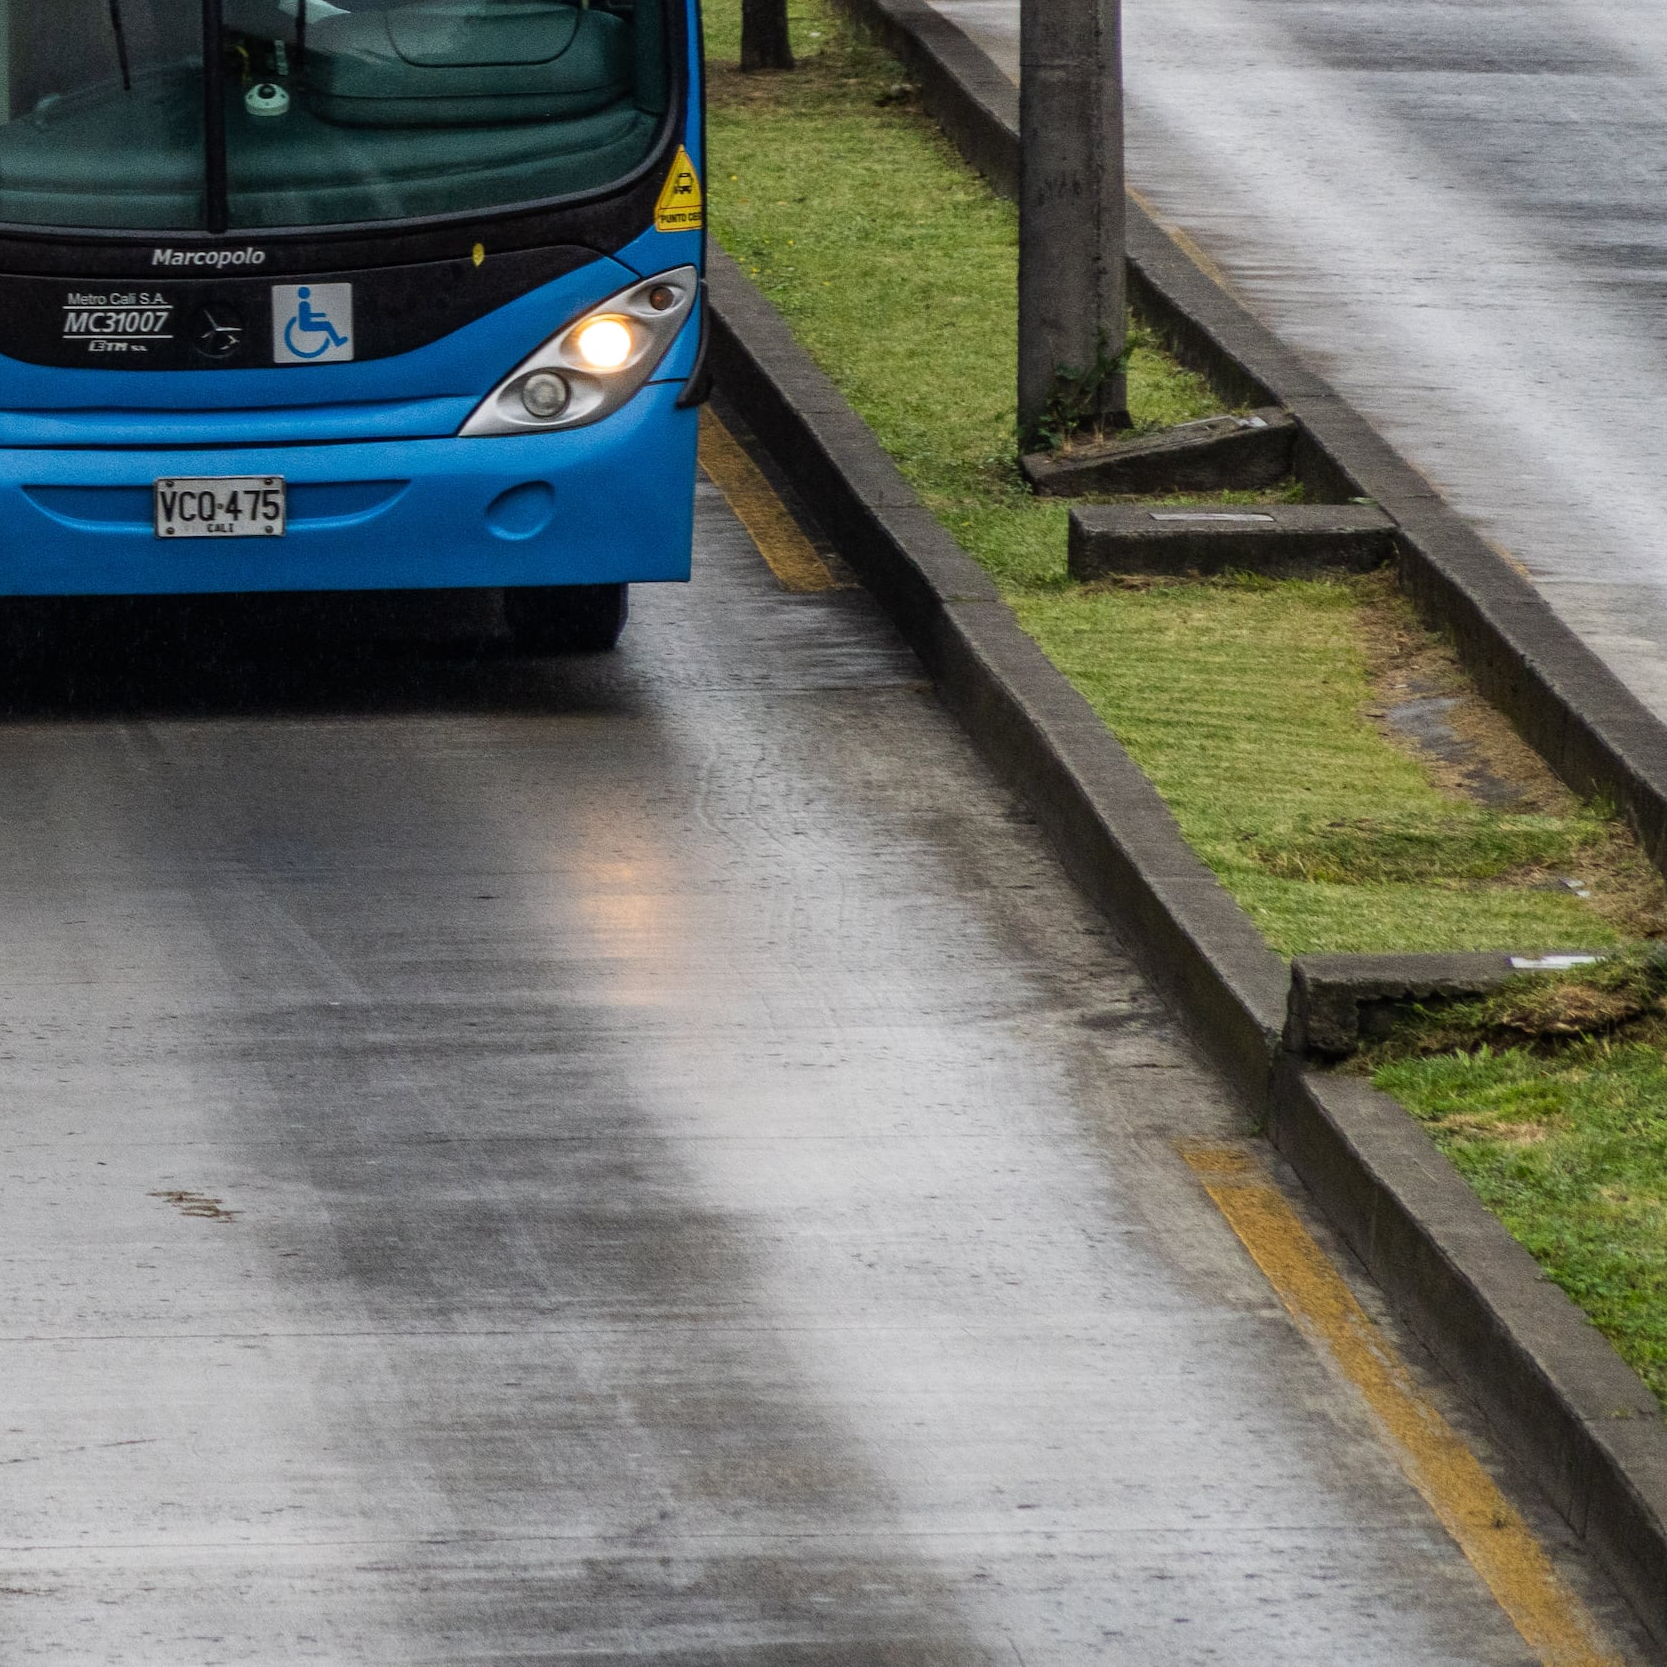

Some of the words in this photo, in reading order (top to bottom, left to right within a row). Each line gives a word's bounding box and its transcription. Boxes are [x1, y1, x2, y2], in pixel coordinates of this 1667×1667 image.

[660, 213, 687, 224] PUNTO
[152, 247, 266, 269] Marcopolo
[68, 293, 107, 306] Metro
[109, 292, 136, 305] Cali
[139, 292, 168, 305] S.A.
[63, 311, 170, 333] MC31007
[206, 523, 235, 533] CALI
